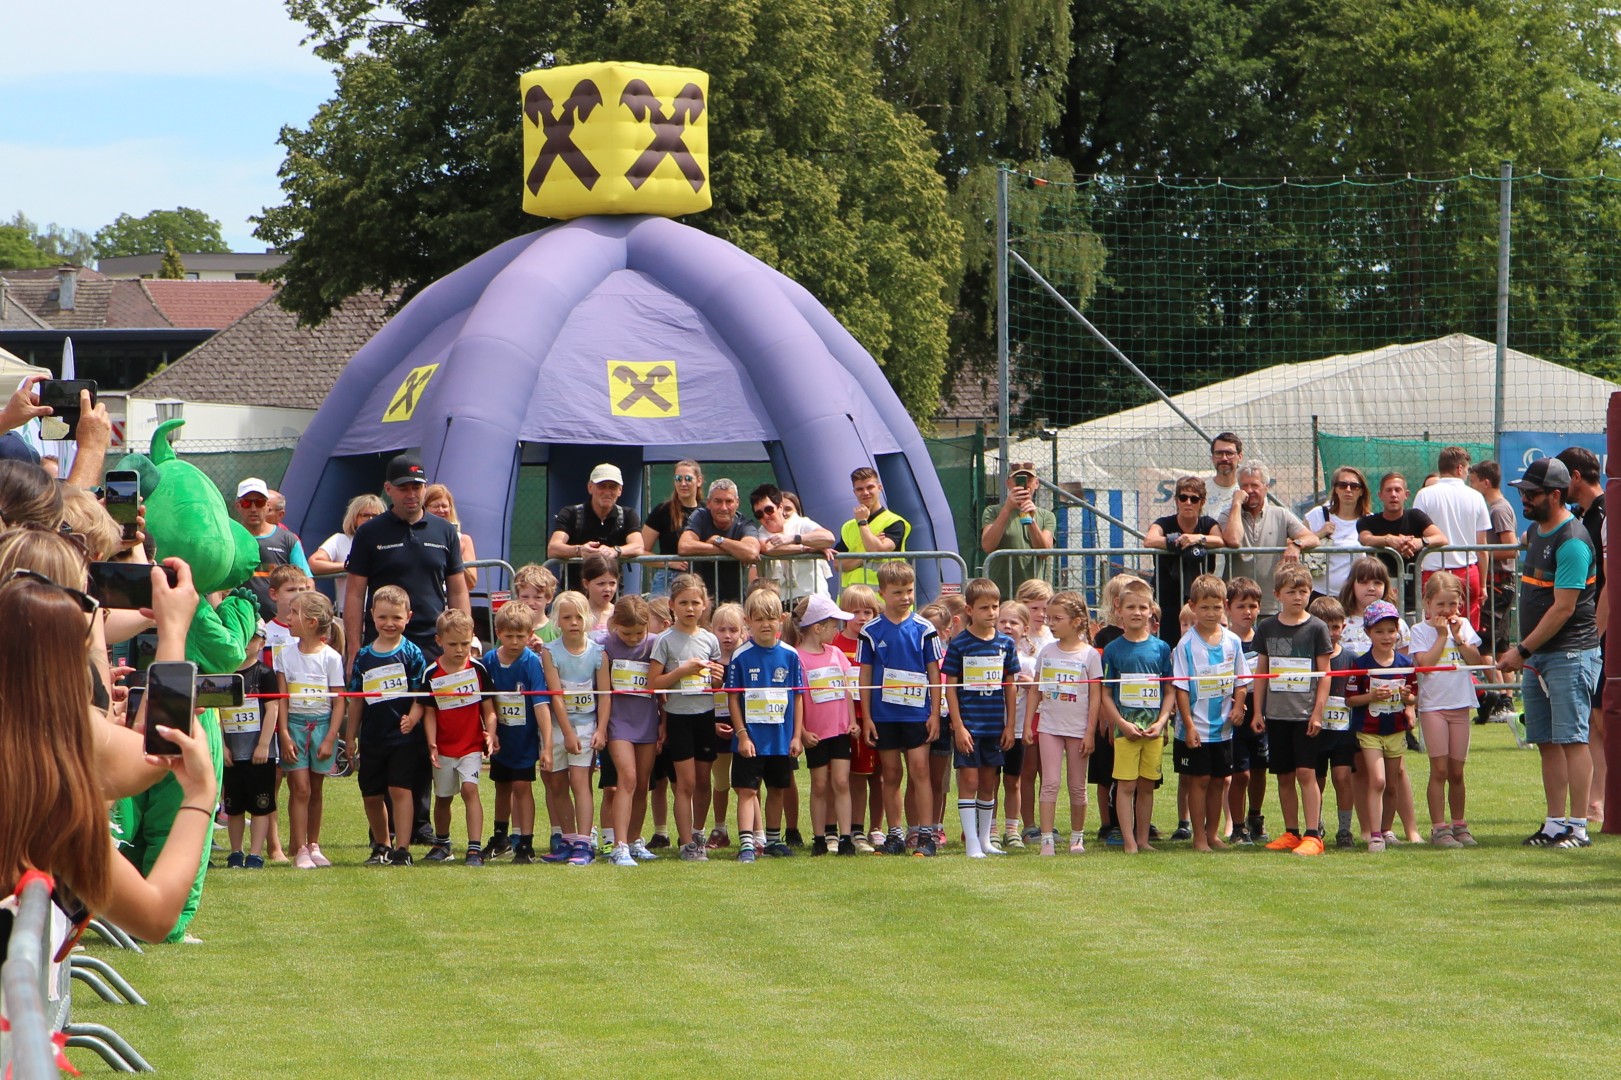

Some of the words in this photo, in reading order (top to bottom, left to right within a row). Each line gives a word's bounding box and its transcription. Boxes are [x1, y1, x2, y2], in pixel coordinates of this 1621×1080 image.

[750, 673, 759, 682] FR
[382, 677, 402, 690] 134
[903, 686, 922, 697] 113
[1142, 688, 1159, 698] 120
[574, 694, 593, 705] 105
[501, 706, 521, 716] 142
[1327, 710, 1345, 721] 137
[235, 711, 256, 723] 133
